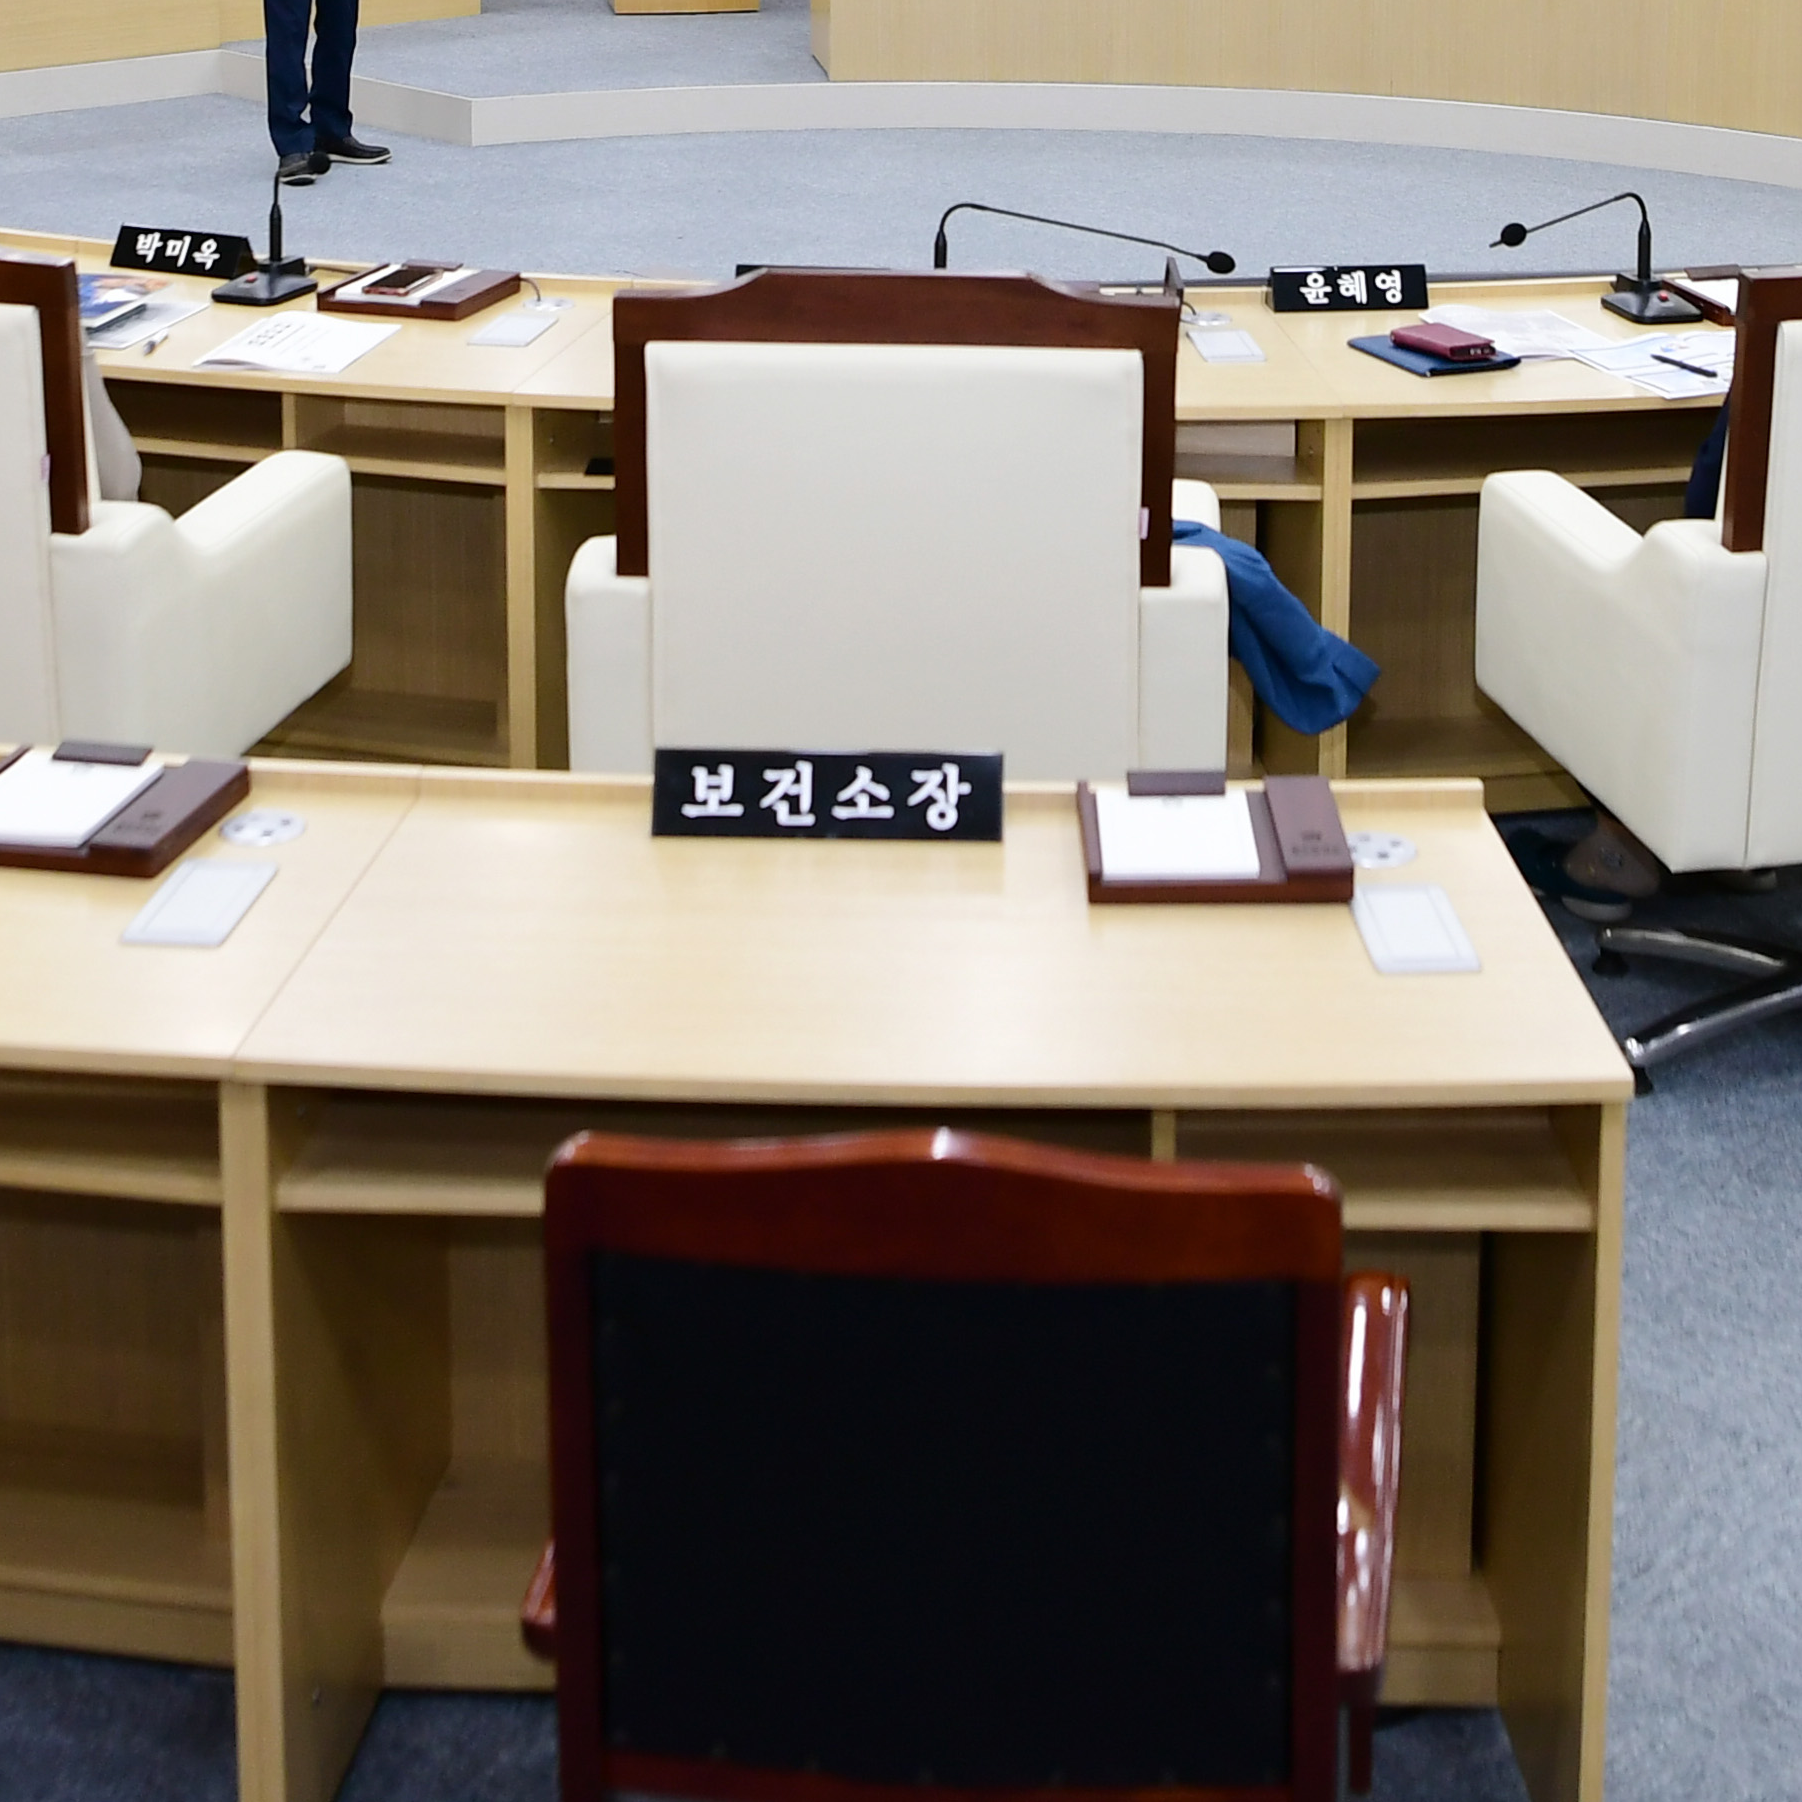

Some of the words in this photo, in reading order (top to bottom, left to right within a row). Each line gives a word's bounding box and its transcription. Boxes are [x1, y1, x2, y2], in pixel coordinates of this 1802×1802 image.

[135, 232, 221, 271] 박미옥
[1299, 269, 1403, 305] 윤혜영
[681, 760, 972, 831] 보건소장
